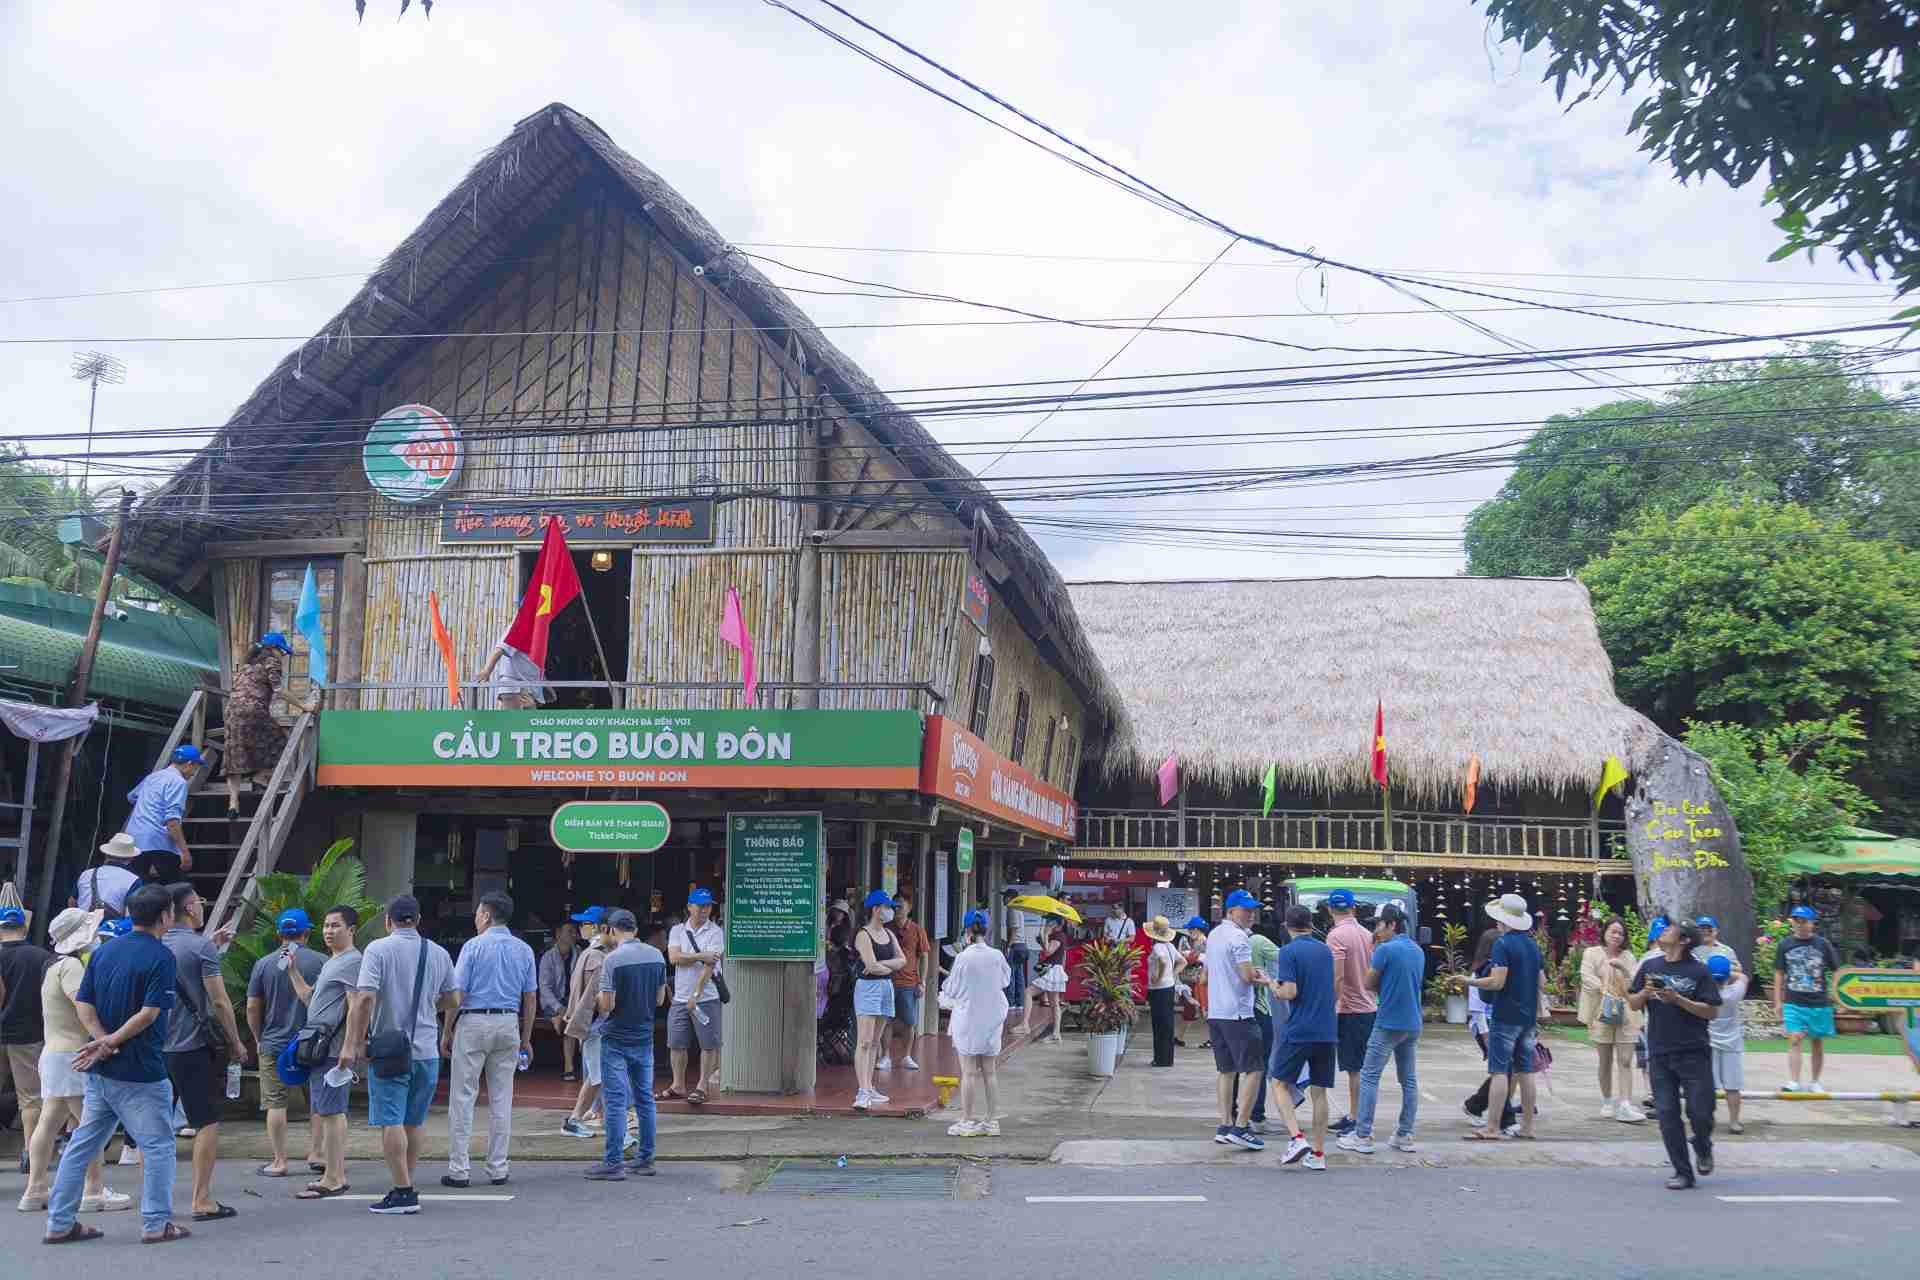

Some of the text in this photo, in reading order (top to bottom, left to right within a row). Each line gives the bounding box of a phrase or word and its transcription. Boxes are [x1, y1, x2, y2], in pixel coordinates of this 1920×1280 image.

[432, 719, 792, 760] CẦU TREO BUÔN ĐÔN
[530, 770, 594, 782] WELCOME
[597, 770, 615, 782] TO
[618, 770, 656, 782] BUON
[589, 831, 639, 841] Ticket Point
[744, 835, 805, 848] THÔNG BÁO
